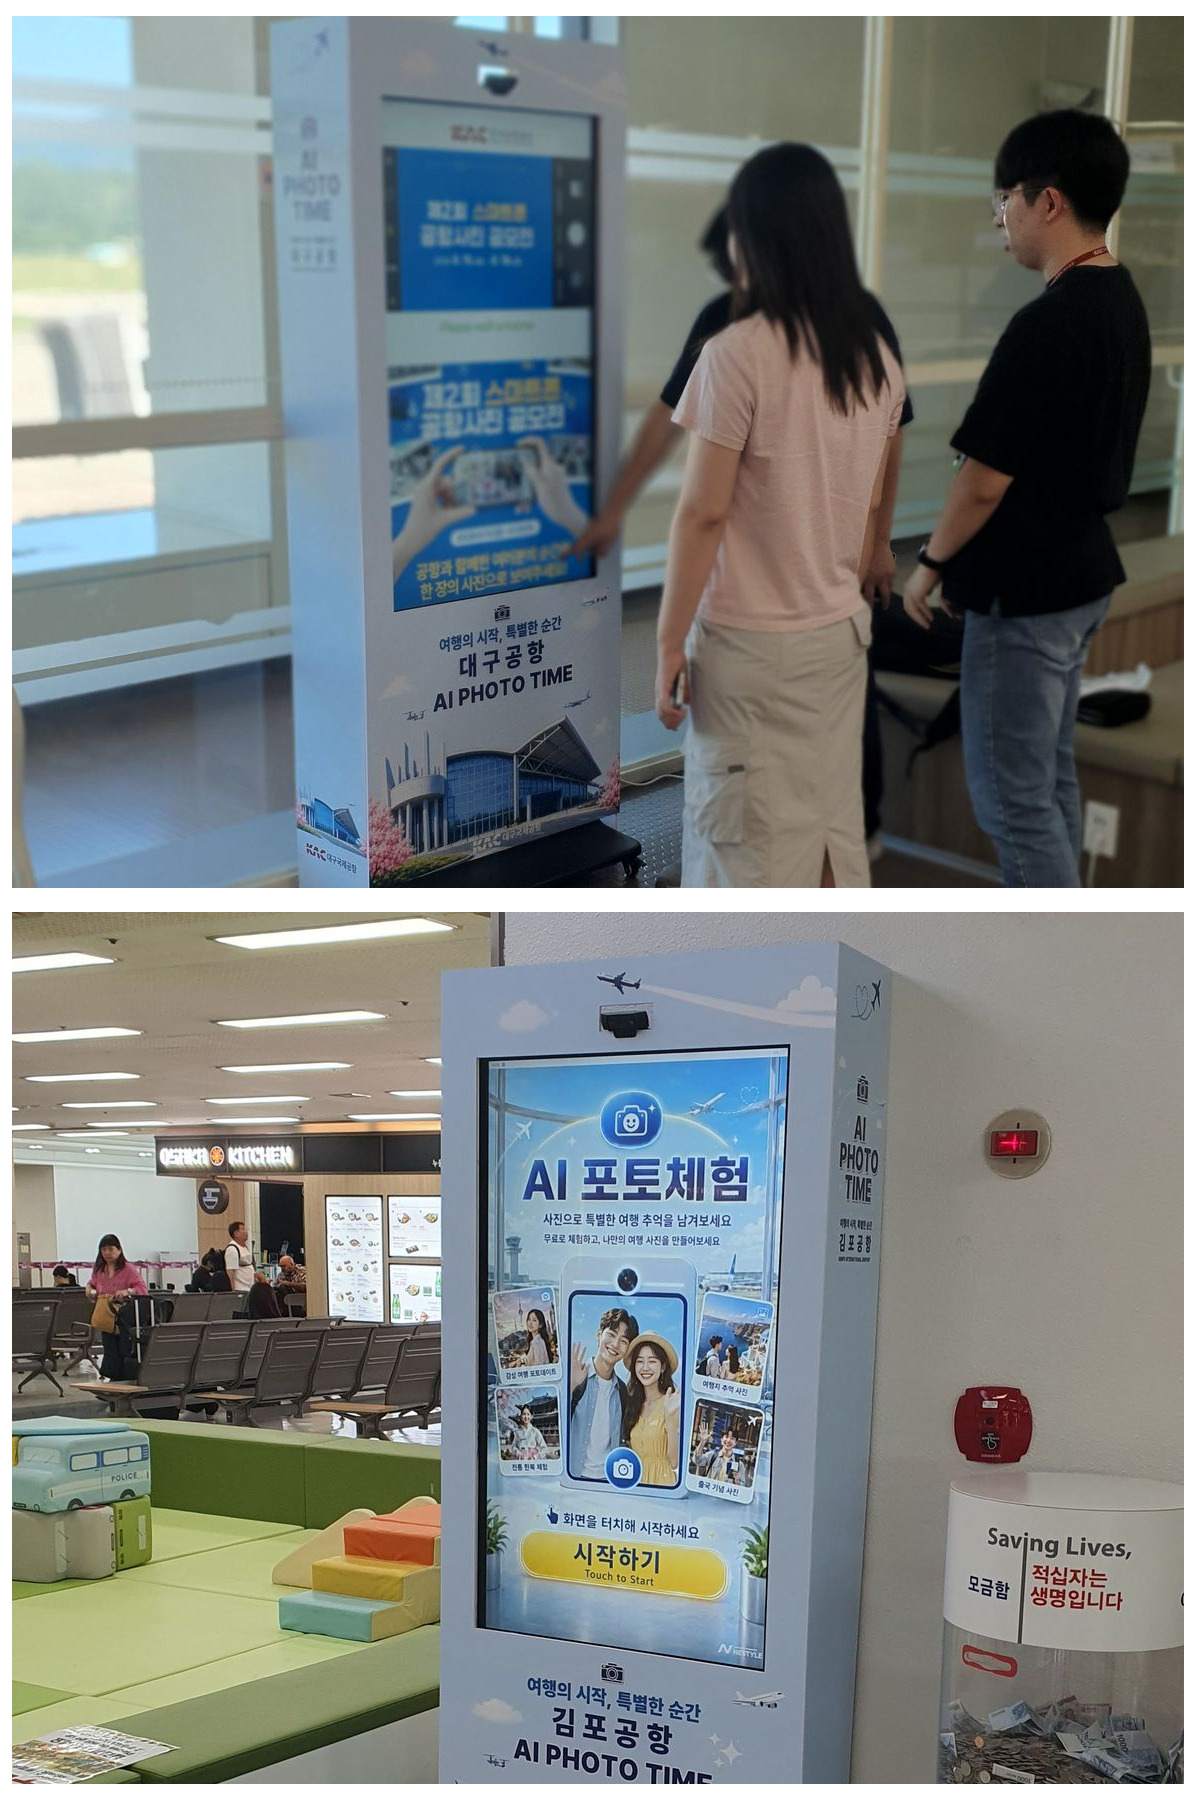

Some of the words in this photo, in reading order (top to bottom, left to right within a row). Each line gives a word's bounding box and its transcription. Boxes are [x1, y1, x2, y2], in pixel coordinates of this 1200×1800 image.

[302, 149, 318, 170] AI
[283, 173, 341, 197] PHOTO
[292, 200, 332, 222] TIME
[416, 560, 452, 581] 공항과
[420, 582, 432, 600] 한
[435, 577, 460, 598] 장의
[461, 570, 508, 592] 사진으로
[440, 632, 473, 652] 여행의
[477, 627, 502, 644] 시작,
[506, 620, 538, 639] 특별한
[540, 616, 562, 633] 순간
[460, 639, 544, 678] 대구공항
[433, 690, 453, 712] AI
[458, 676, 525, 706] PHOTO
[530, 664, 573, 689] TIME
[854, 1115, 866, 1142] AI
[160, 1147, 209, 1166] OSAKA
[228, 1146, 293, 1166] KITCHEN
[839, 1142, 878, 1174] PHOTO
[522, 1159, 567, 1200] AI
[581, 1156, 748, 1202] 포토체험
[846, 1174, 872, 1202] TIME
[543, 1214, 582, 1226] 사진으로
[585, 1213, 616, 1227] 특별한
[618, 1214, 639, 1228] 여행
[642, 1214, 673, 1228] 추억을
[677, 1214, 732, 1228] 남겨보세요
[544, 1234, 566, 1244] 무료로
[568, 1234, 601, 1246] 체험하고,
[603, 1234, 626, 1245] 나만의
[628, 1234, 643, 1246] 여행
[646, 1235, 669, 1246] 사진을
[672, 1235, 720, 1247] 만들어보세요
[839, 1233, 871, 1253] 김포공항
[111, 1472, 138, 1482] POLICE
[563, 1513, 597, 1529] 화면을
[601, 1516, 636, 1533] 터치해
[640, 1520, 700, 1540] 시작하세요
[988, 1527, 1059, 1558] Saving
[1066, 1537, 1132, 1560] Lives,
[573, 1542, 660, 1574] 시작하기
[584, 1569, 613, 1582] Touch
[617, 1572, 628, 1583] to
[630, 1574, 654, 1587] Start
[968, 1575, 1010, 1600] 모금함
[1032, 1565, 1108, 1588] 적십자는
[1030, 1586, 1123, 1611] 생명입니다
[527, 1677, 572, 1701] 여행의
[576, 1685, 611, 1710] 시작,
[616, 1691, 664, 1718] 특별한
[668, 1701, 701, 1723] 순간
[552, 1707, 673, 1755] 김포공항
[514, 1738, 539, 1763] AI
[546, 1744, 638, 1781] PHOTO
